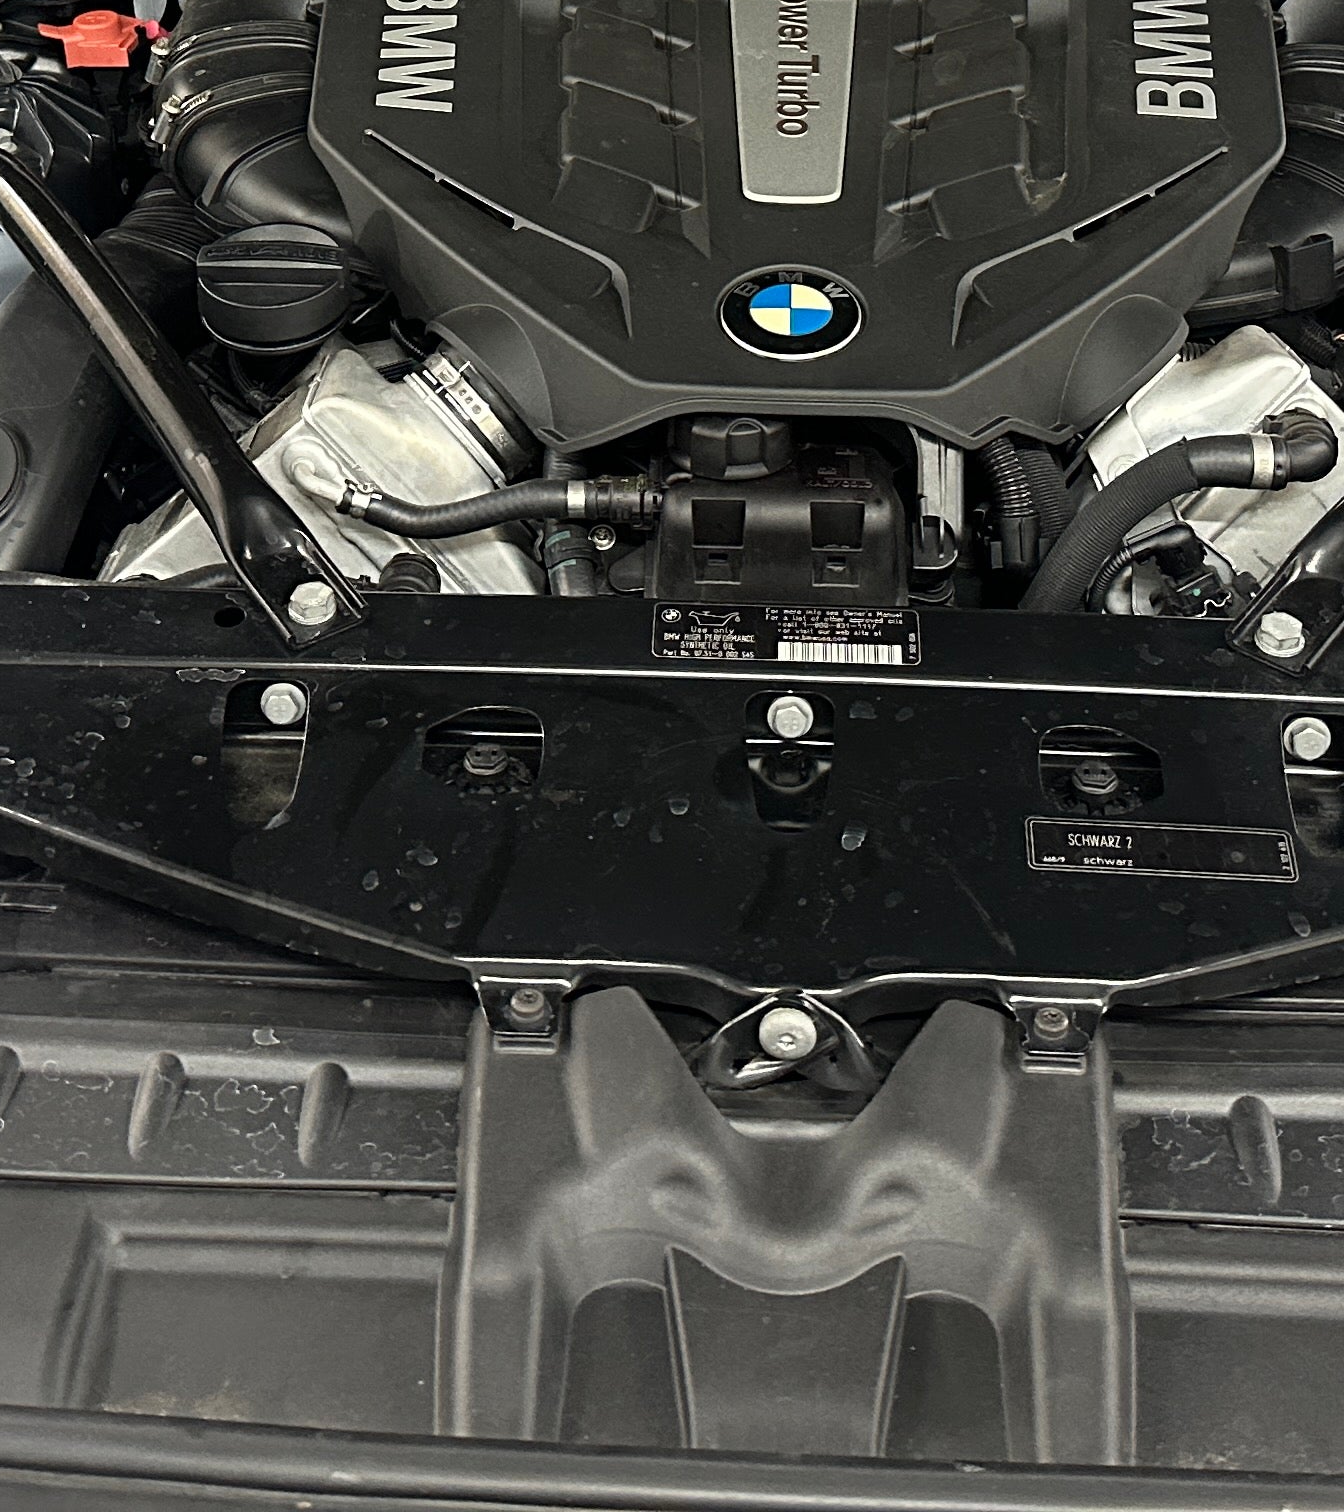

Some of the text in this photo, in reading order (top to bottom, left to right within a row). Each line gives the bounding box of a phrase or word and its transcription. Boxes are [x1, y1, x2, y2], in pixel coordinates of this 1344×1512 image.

[776, 55, 821, 138] Turbo
[734, 272, 849, 299] BMW
[680, 640, 735, 650] SYNTHETIC OIL
[704, 634, 756, 642] PERFORMANCE
[1068, 833, 1133, 850] SCHWARZ 2
[1084, 856, 1134, 867] schwarz
